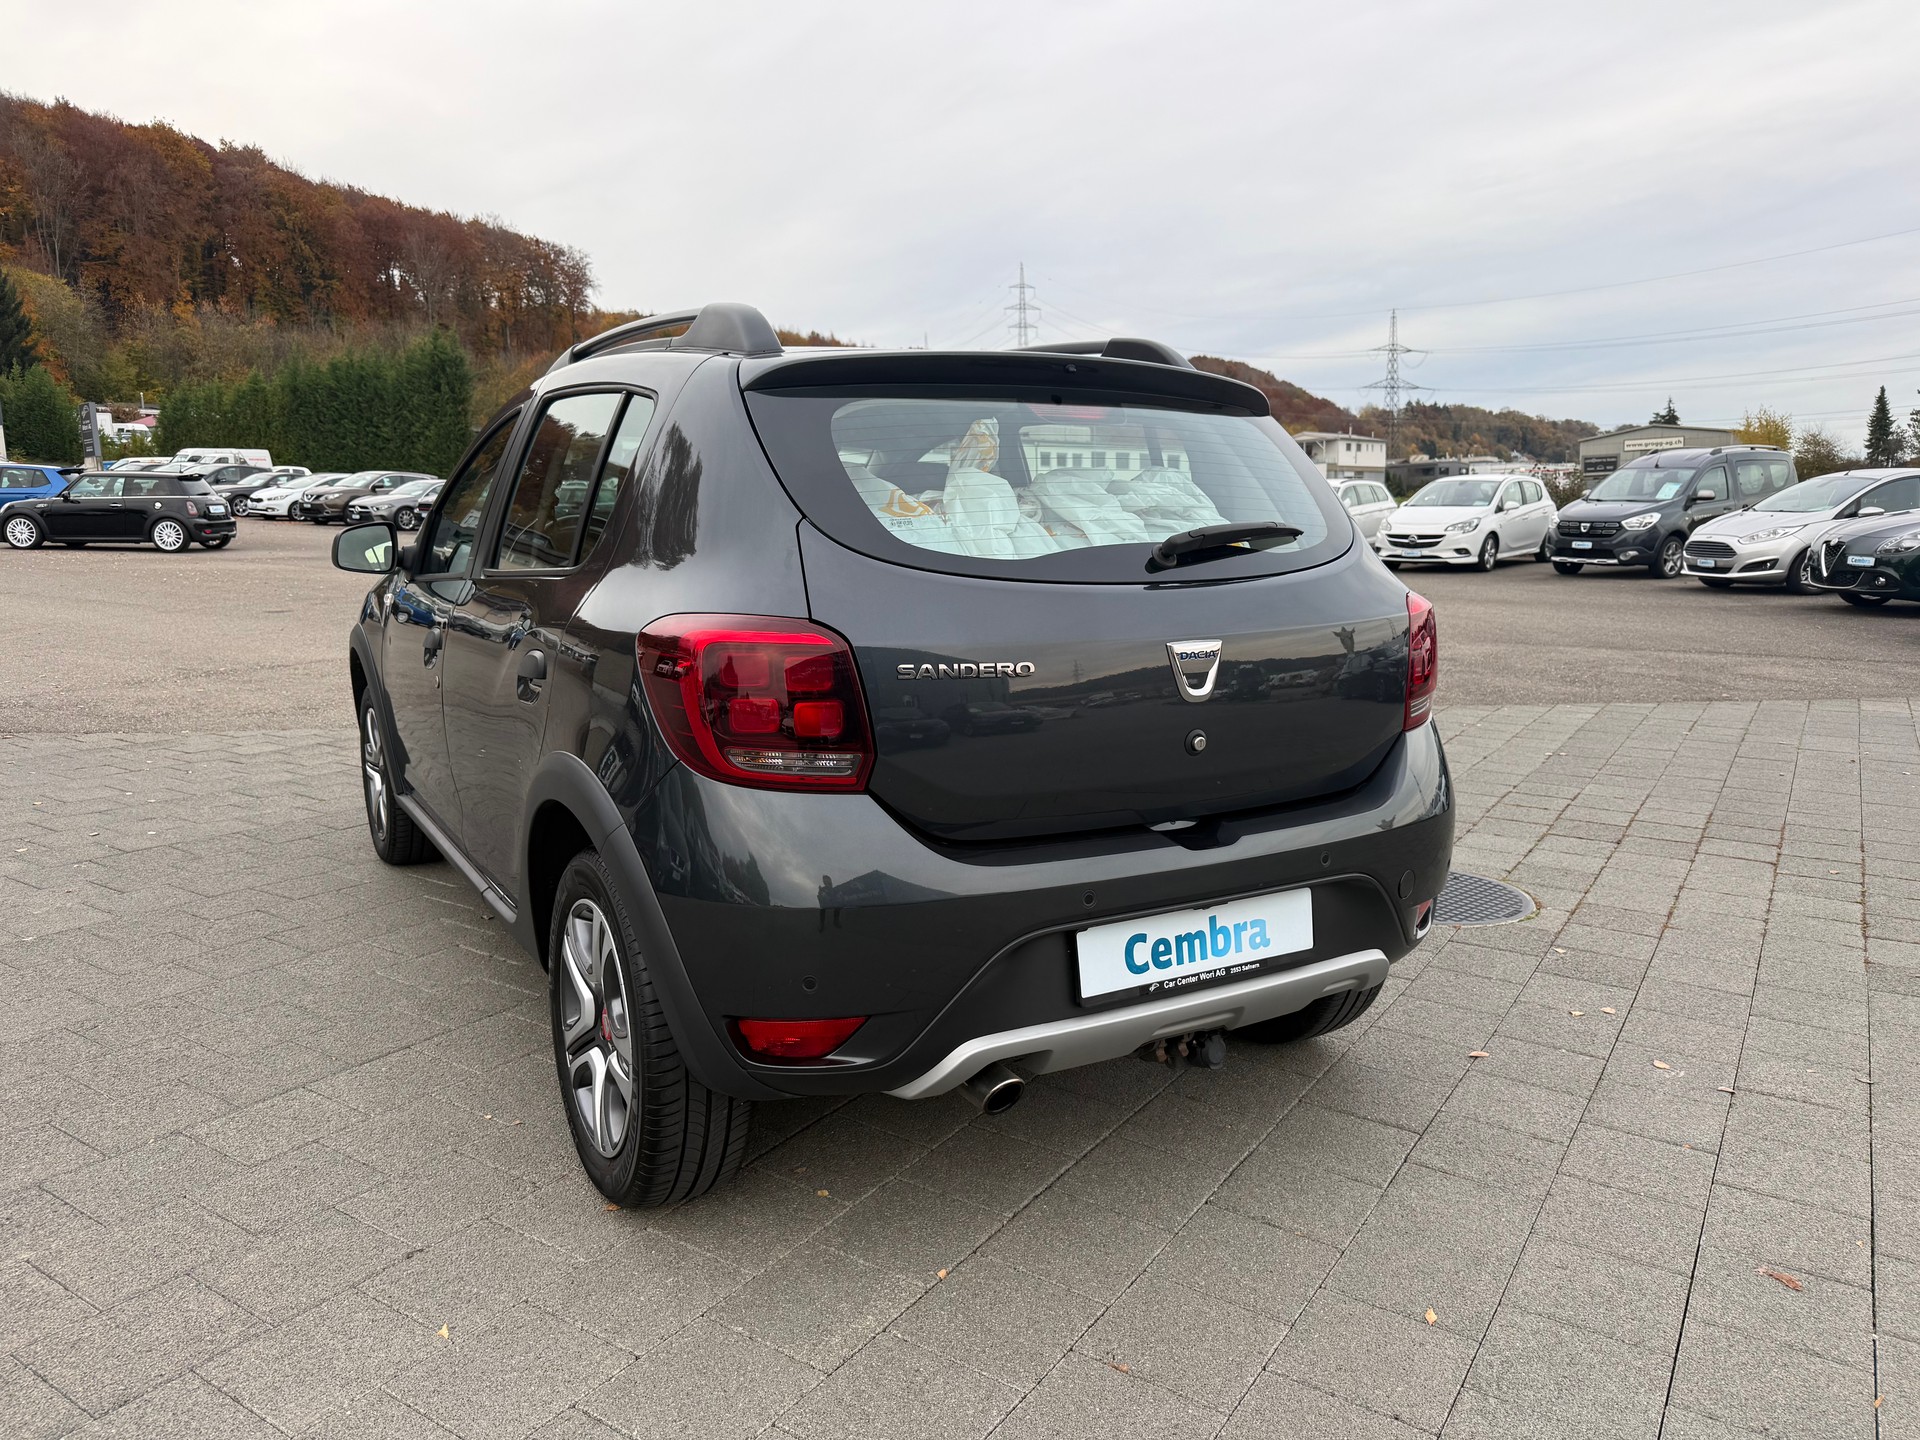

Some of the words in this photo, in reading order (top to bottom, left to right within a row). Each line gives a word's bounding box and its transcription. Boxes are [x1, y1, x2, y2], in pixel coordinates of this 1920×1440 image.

[1180, 650, 1216, 660] DACIA
[896, 661, 1035, 681] SANDERO
[1124, 915, 1271, 975] Cembra
[1163, 980, 1176, 989] Car
[1177, 975, 1199, 985] Center
[1216, 968, 1226, 977] AG
